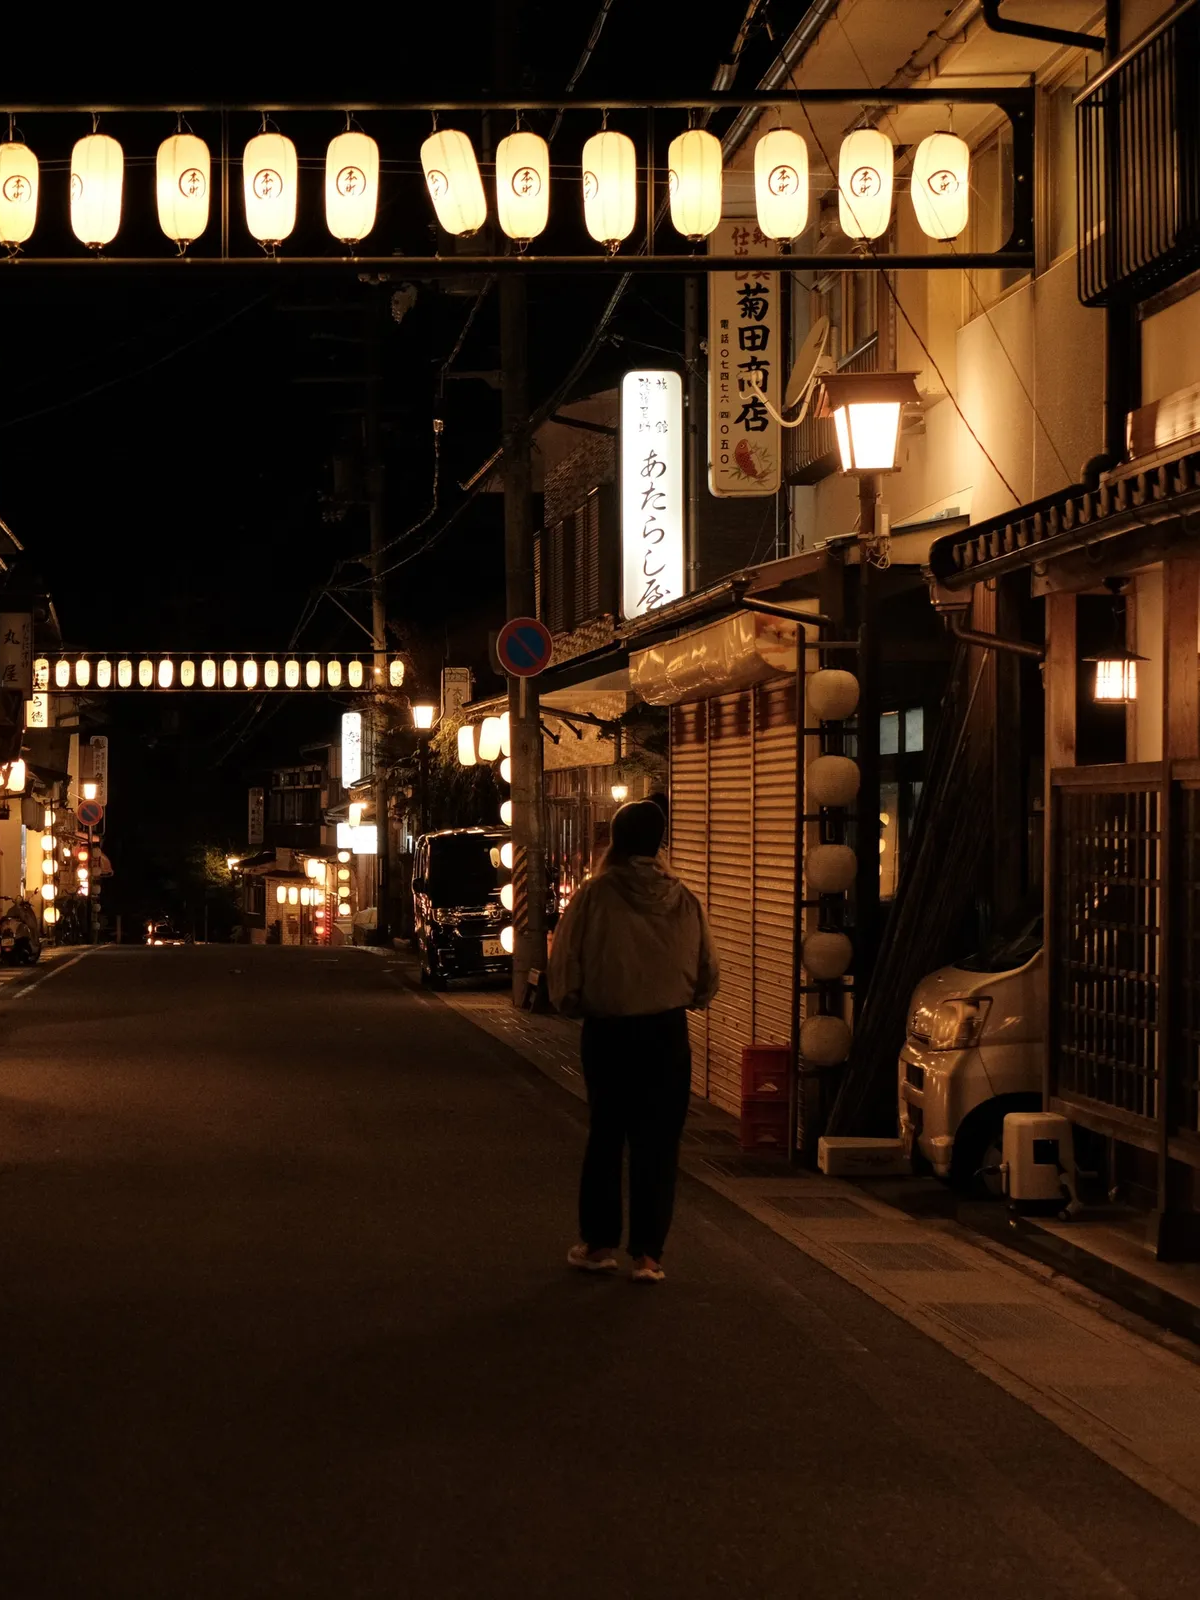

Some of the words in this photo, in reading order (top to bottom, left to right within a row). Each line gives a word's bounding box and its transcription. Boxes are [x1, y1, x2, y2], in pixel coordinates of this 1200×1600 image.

[733, 282, 771, 432] 菊田商店
[2, 628, 20, 683] 丸屋
